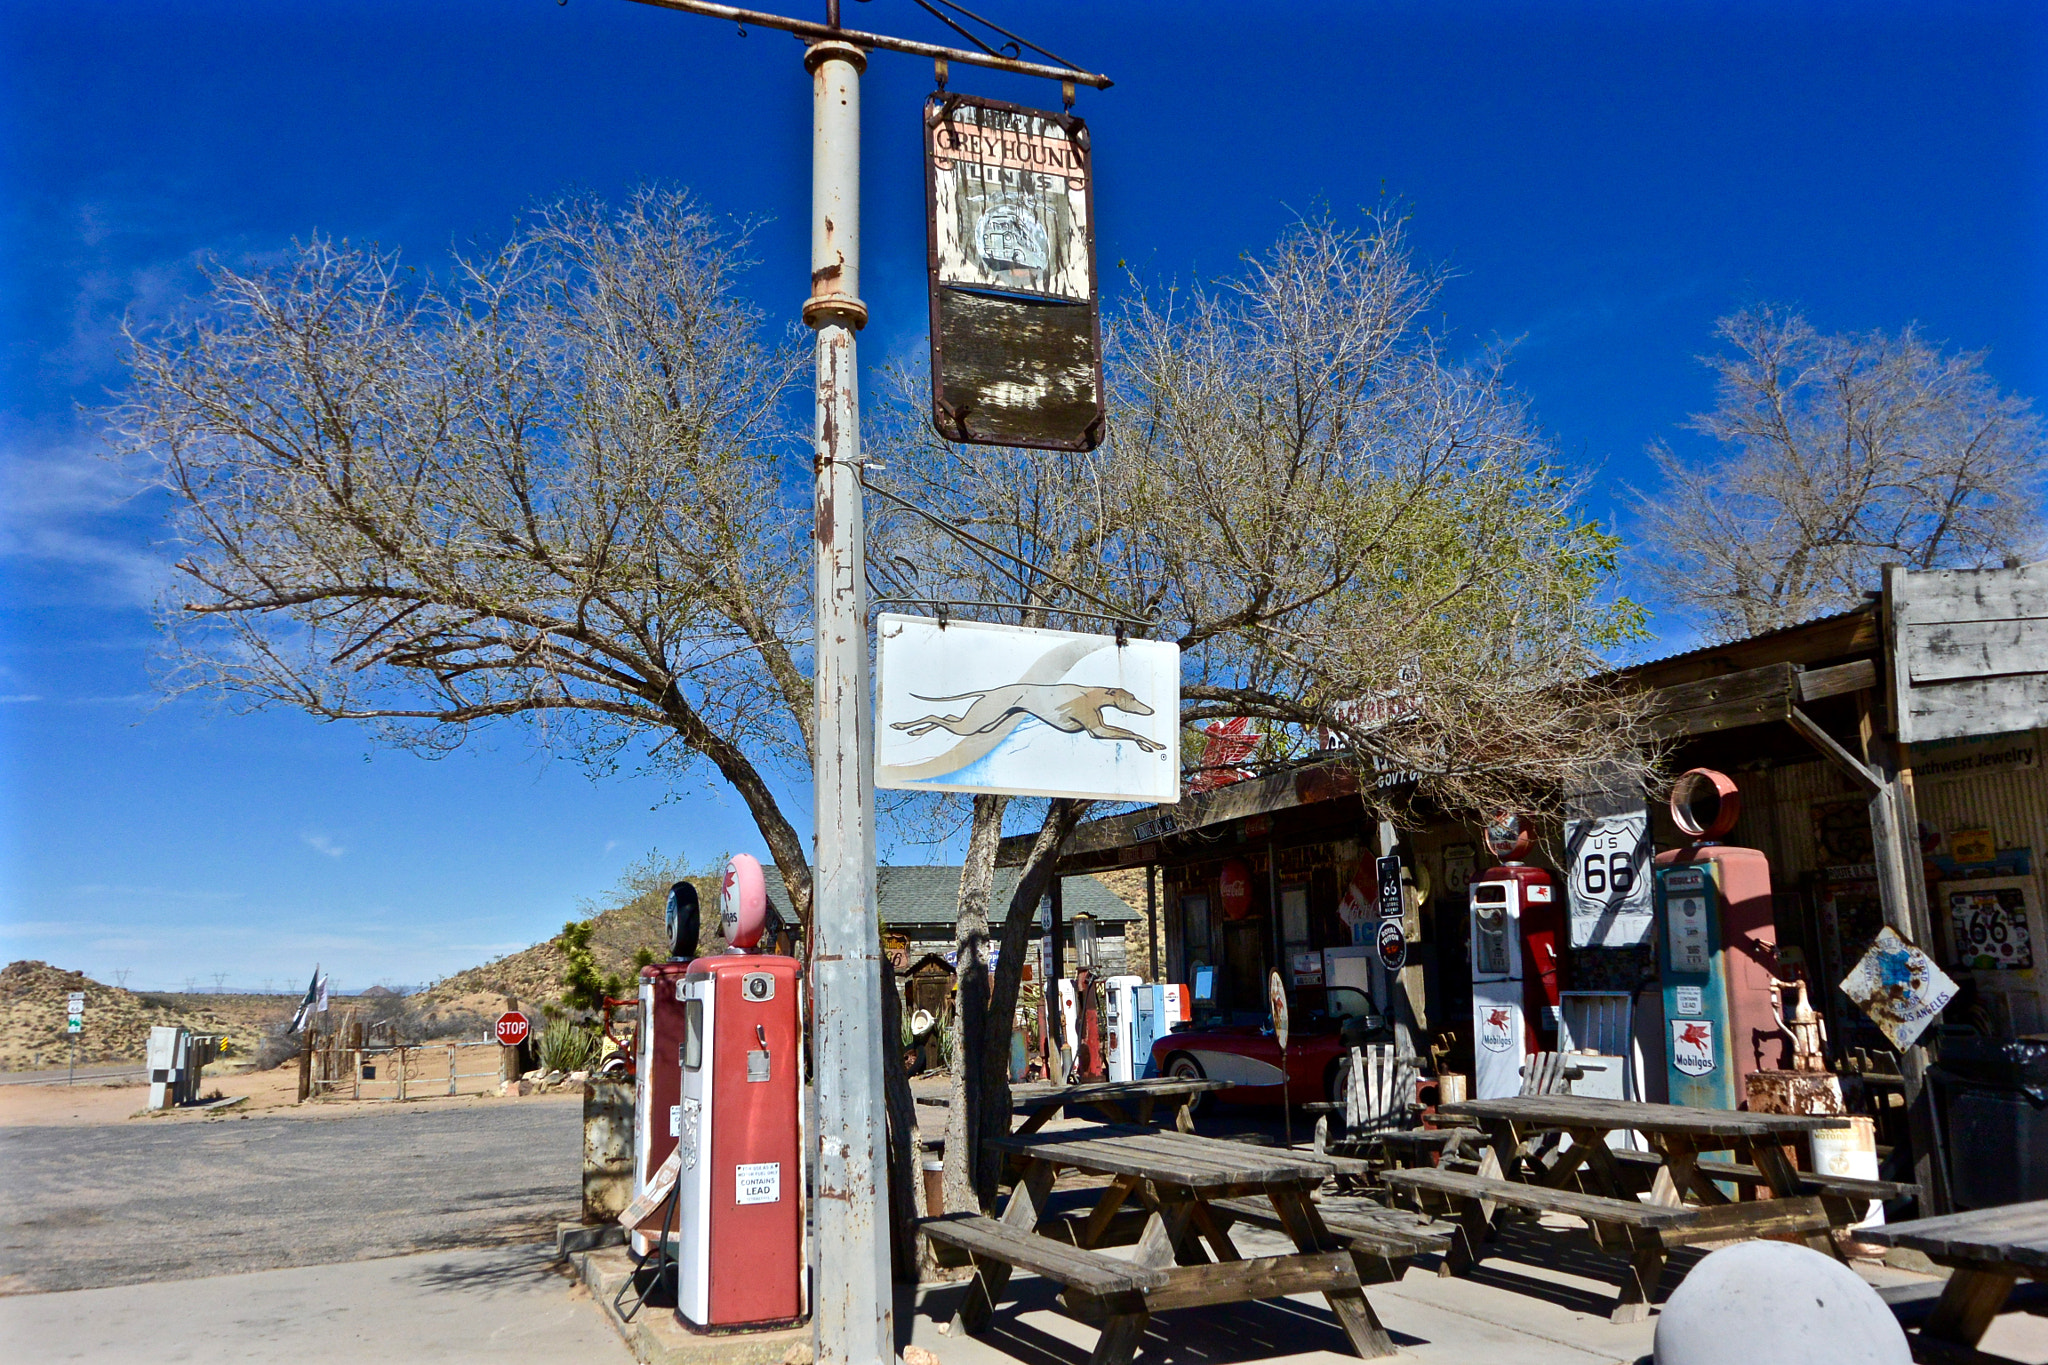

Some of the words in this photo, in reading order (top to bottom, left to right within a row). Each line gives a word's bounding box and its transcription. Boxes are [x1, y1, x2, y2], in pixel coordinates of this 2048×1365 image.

[937, 129, 1085, 169] GREYHOUND
[969, 165, 1050, 189] LINS
[1910, 756, 1973, 777] outhwest
[1976, 747, 2033, 769] Jewelry
[1584, 851, 1633, 894] 66
[1383, 880, 1397, 896] 66
[1381, 926, 1398, 939] ROYAL
[1969, 910, 2008, 945] 66
[1382, 934, 1400, 946] TRITON
[1916, 991, 1951, 1019] ANGELES
[498, 1021, 526, 1035] STOP
[1484, 1034, 1512, 1046] Mobilgas
[1676, 1054, 1713, 1070] Mobilgas
[741, 1177, 776, 1186] CONTAINS
[746, 1186, 771, 1196] LEAD
